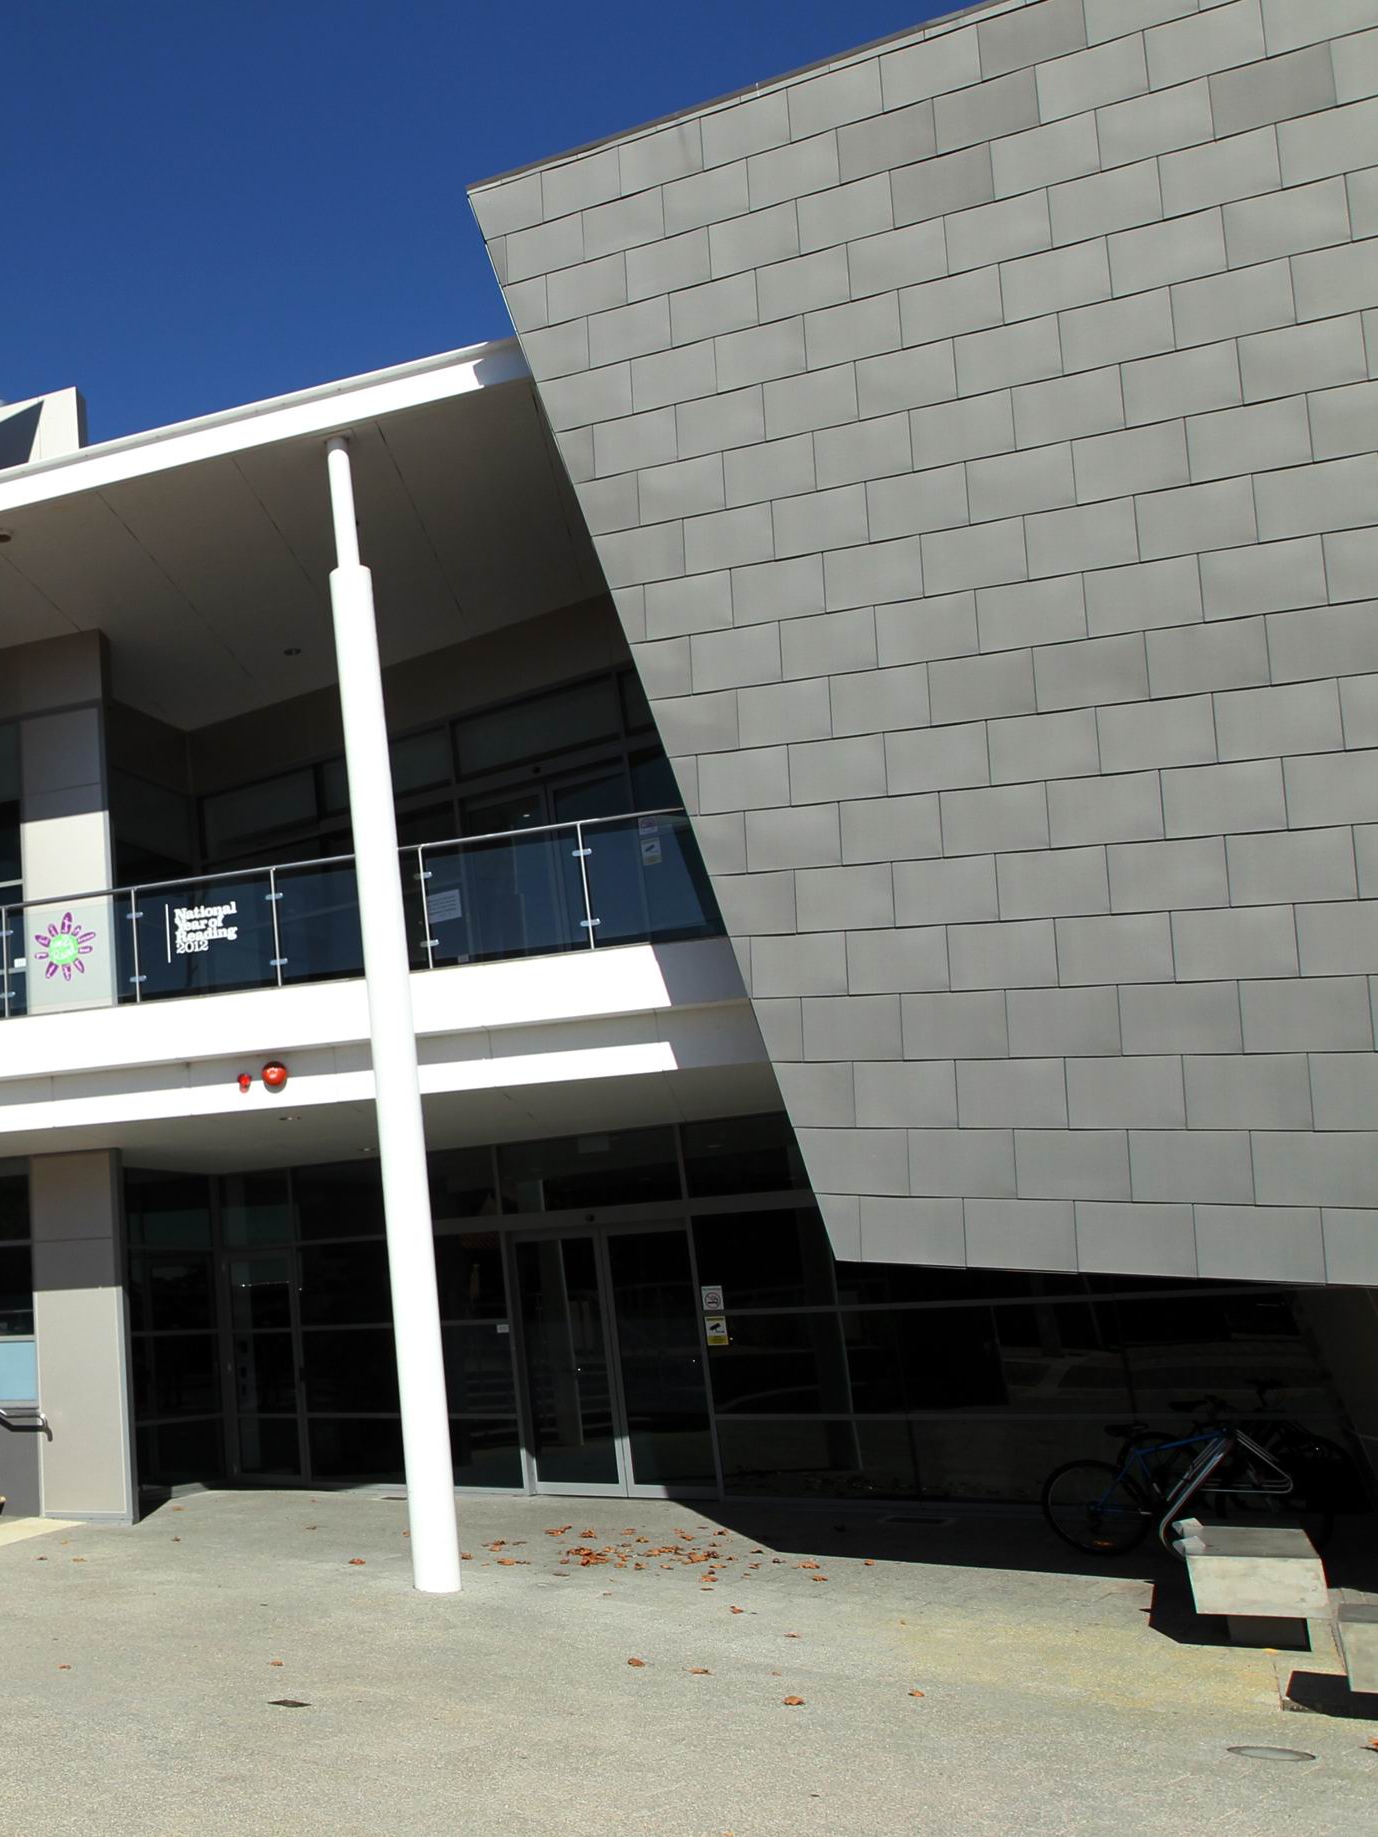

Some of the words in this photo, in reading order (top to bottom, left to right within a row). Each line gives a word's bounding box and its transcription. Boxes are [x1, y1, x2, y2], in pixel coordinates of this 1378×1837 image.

[174, 901, 237, 920] National
[174, 917, 207, 932] Year
[208, 914, 224, 927] of
[175, 926, 238, 943] Reading
[176, 940, 208, 954] 2012
